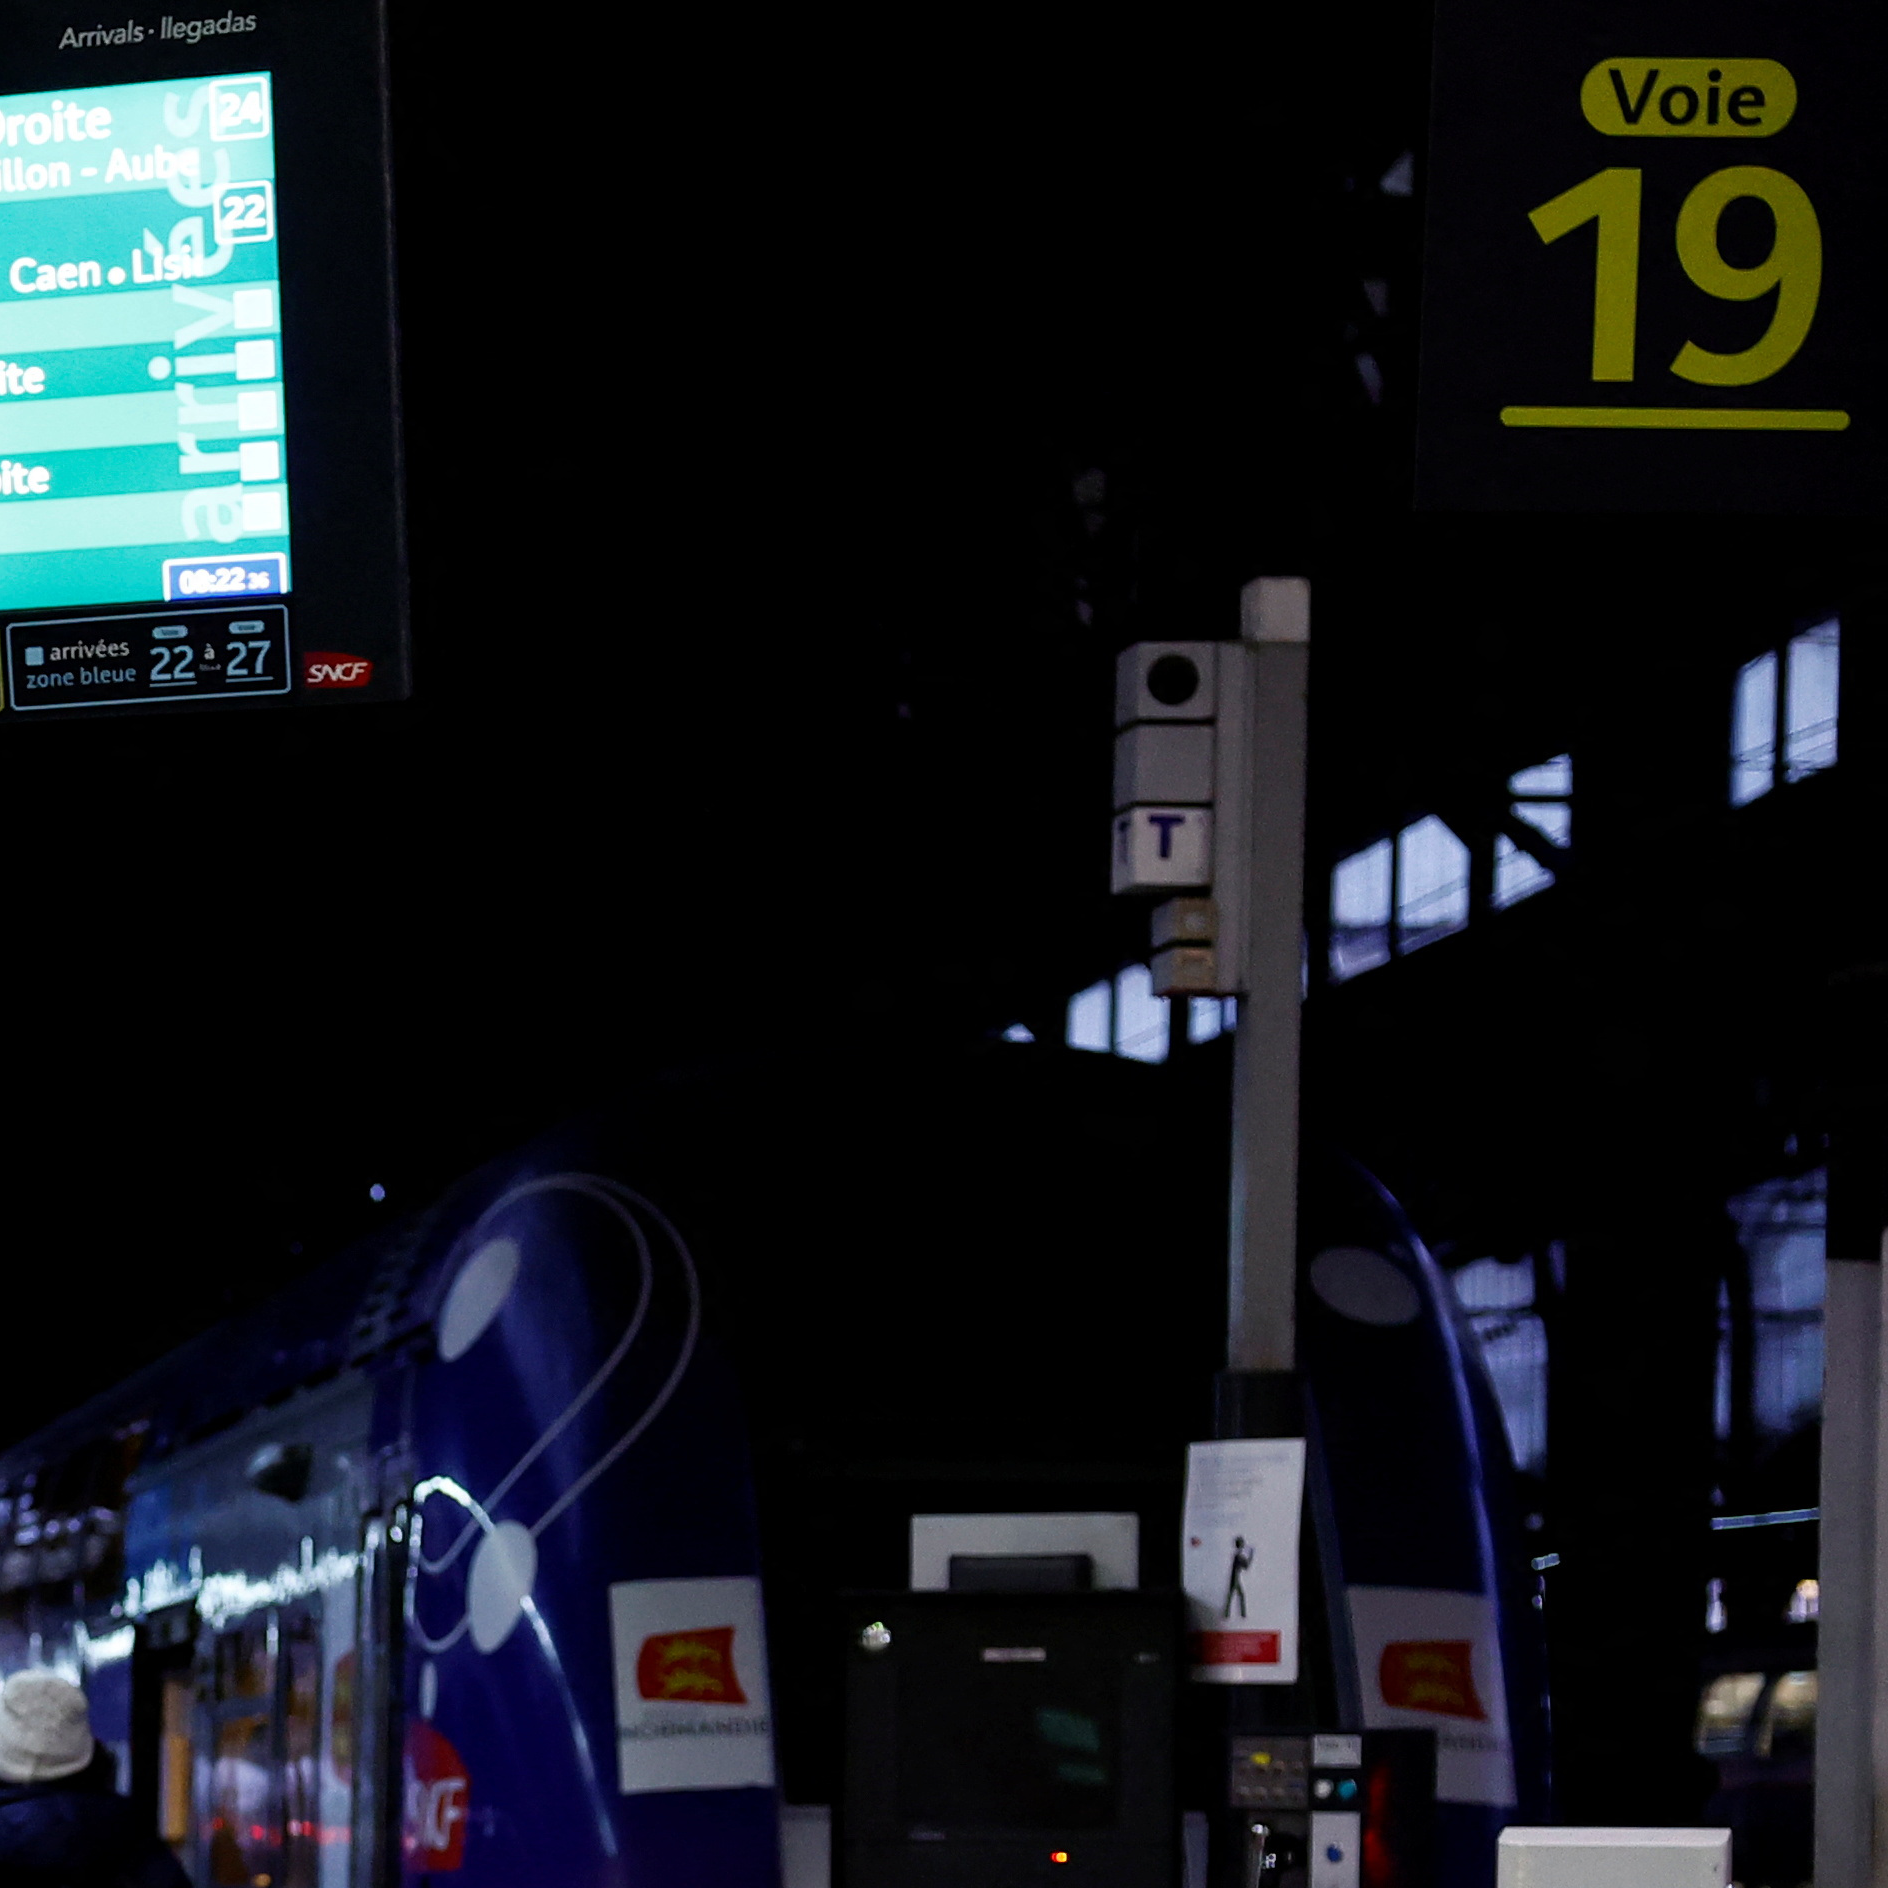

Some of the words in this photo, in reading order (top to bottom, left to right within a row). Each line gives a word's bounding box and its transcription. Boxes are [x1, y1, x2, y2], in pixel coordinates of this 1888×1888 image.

[58, 19, 147, 50] Arrivals
[159, 10, 258, 45] llegadas
[218, 92, 262, 127] 24
[1608, 68, 1766, 126] Voie
[221, 196, 266, 231] 22
[10, 258, 101, 293] Caen
[1527, 164, 1822, 387] 19
[145, 85, 243, 542] arrivées
[25, 668, 74, 690] zone
[79, 664, 137, 685] bleue
[50, 638, 131, 663] arrivées
[149, 644, 196, 680] 22
[226, 640, 271, 675] 27
[307, 661, 368, 683] SNCF
[1149, 816, 1185, 858] T
